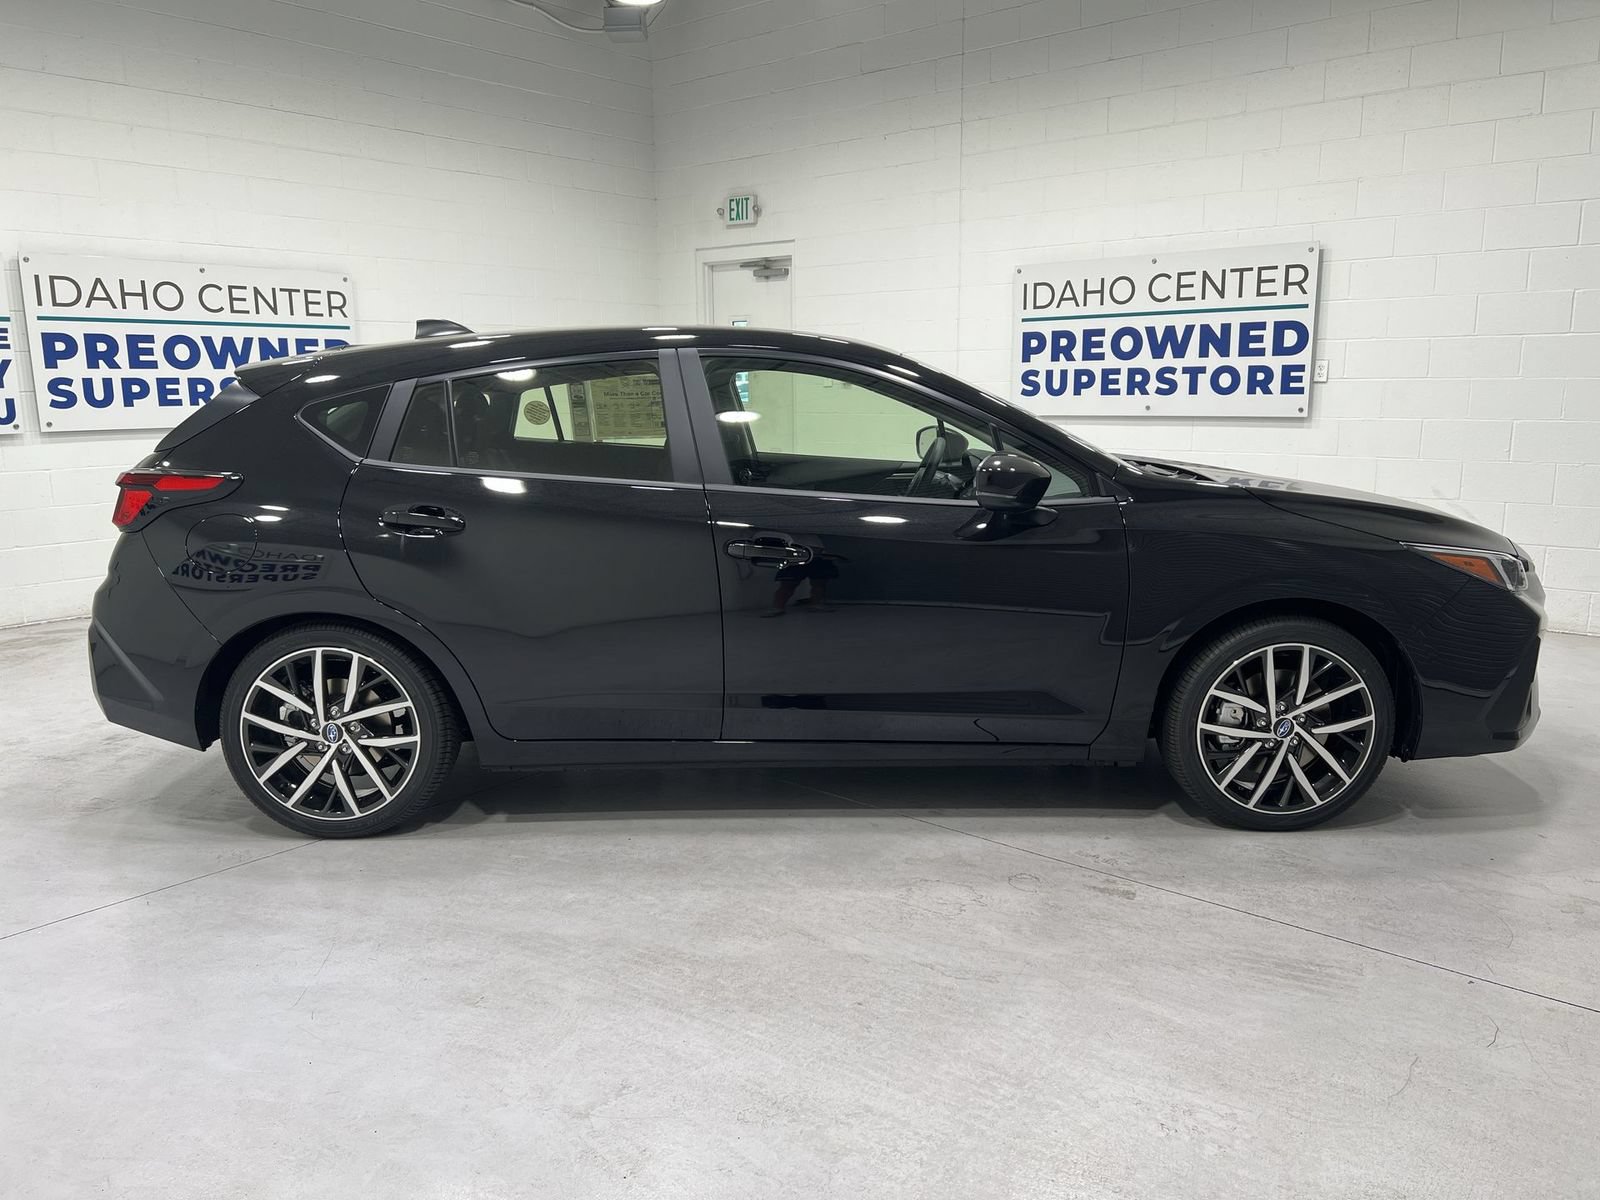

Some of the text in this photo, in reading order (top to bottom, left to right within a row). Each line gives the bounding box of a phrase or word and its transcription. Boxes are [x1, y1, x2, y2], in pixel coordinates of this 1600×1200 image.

[728, 197, 750, 222] EXIT
[33, 274, 349, 318] IDAHO CENTER
[1022, 263, 1310, 310] IDAHO CENTER
[40, 331, 351, 370] PREOWN
[1021, 320, 1310, 363] PREOWNED
[1020, 364, 1306, 397] SUPERSTORE
